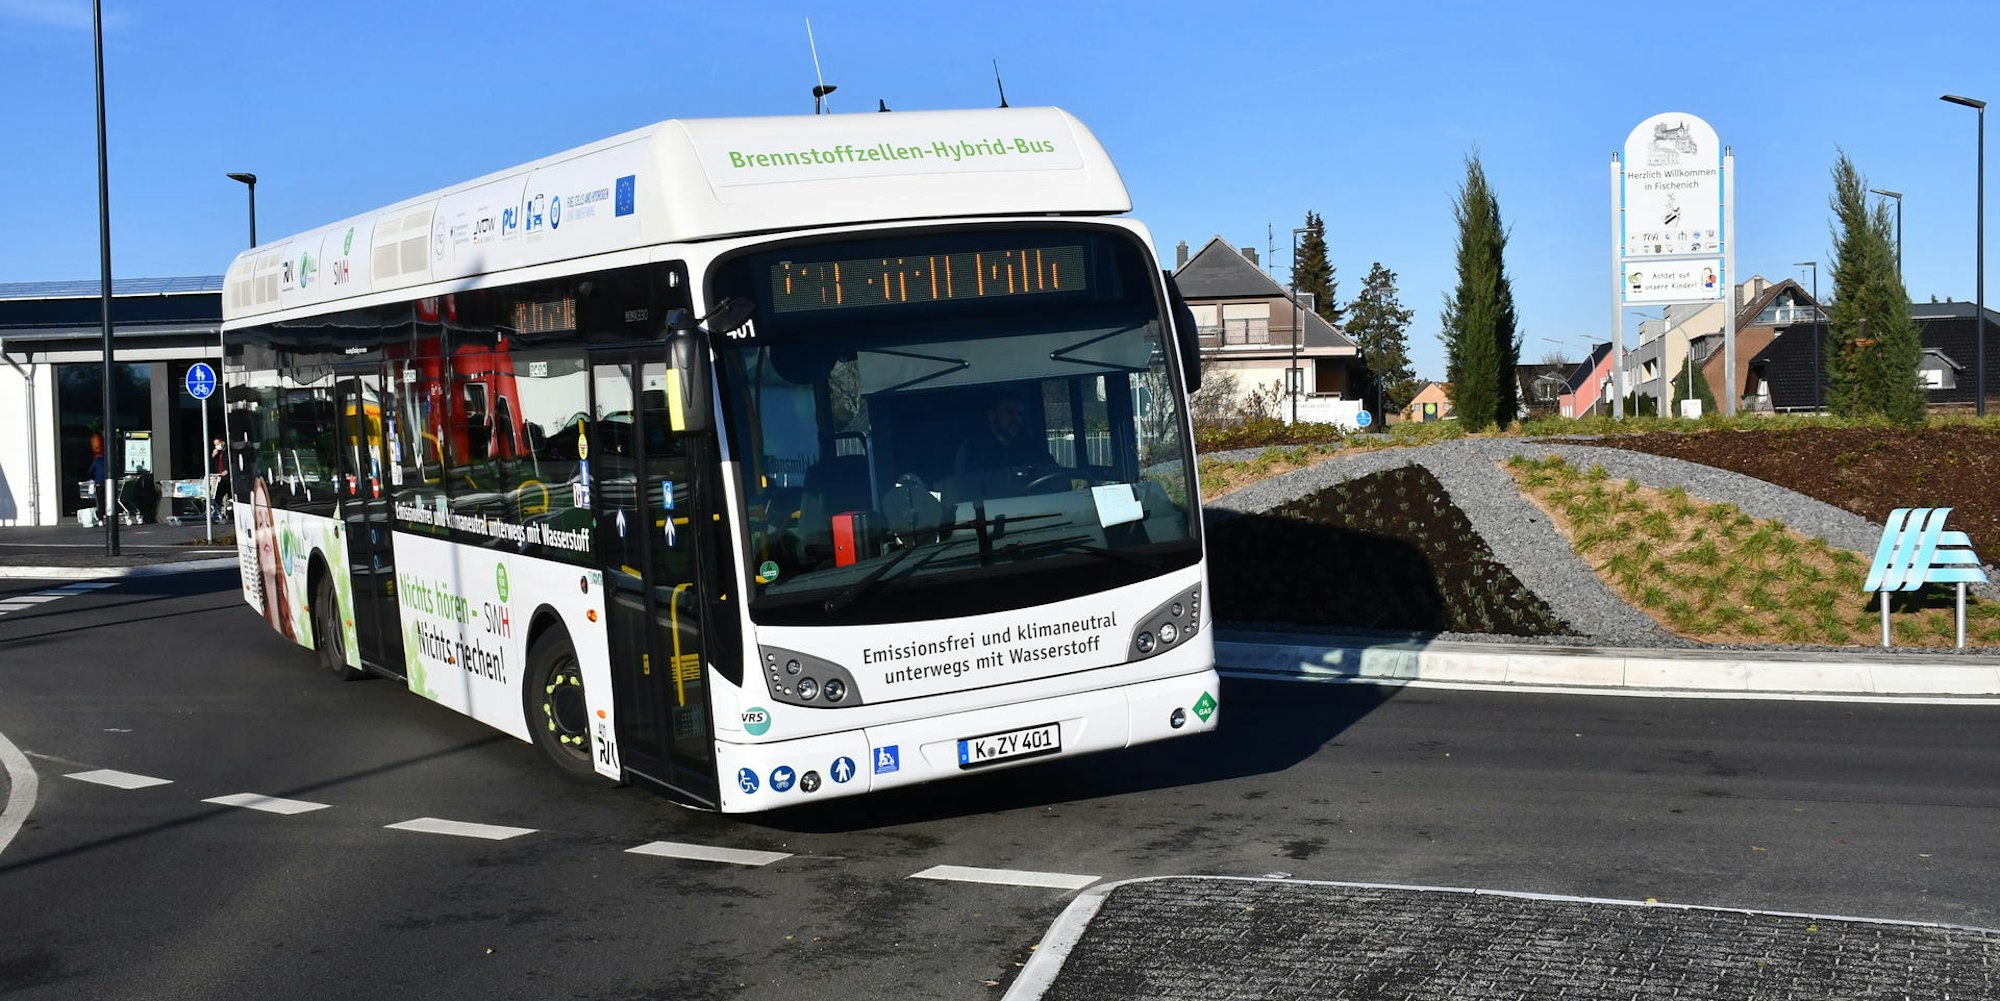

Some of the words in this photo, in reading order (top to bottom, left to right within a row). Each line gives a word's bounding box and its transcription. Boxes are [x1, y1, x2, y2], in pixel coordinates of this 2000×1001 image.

[728, 137, 1055, 169] Brennstoffzellen-Hybrid-Bus
[1628, 171, 1661, 179] Herzlich
[1664, 169, 1717, 178] Willkommen
[1644, 182, 1652, 190] in
[1655, 180, 1699, 190] Fischenich
[1652, 272, 1676, 280] Achtet
[1679, 271, 1690, 279] auf
[395, 501, 433, 525] Emissionsfrei
[434, 505, 446, 527] und
[446, 508, 488, 535] klimaneutral
[489, 518, 526, 547] unterwegs
[527, 521, 541, 545] mit
[541, 523, 590, 553] Wasserstoff
[400, 572, 434, 615] Nichts
[435, 580, 470, 625] hören
[484, 602, 511, 639] SWH
[417, 620, 453, 665] Nichts
[455, 632, 507, 685] riechen!
[863, 633, 975, 664] Emissionsfrei
[982, 627, 1012, 647] und
[1017, 611, 1117, 641] klimaneutral
[885, 659, 970, 684] unterwegs
[976, 652, 1005, 670] mit
[1009, 635, 1101, 664] Wasserstoff
[741, 712, 764, 723] VRS
[1199, 707, 1212, 715] GAS
[976, 740, 986, 758] K
[997, 734, 1018, 755] ZY
[1022, 729, 1052, 750] 401
